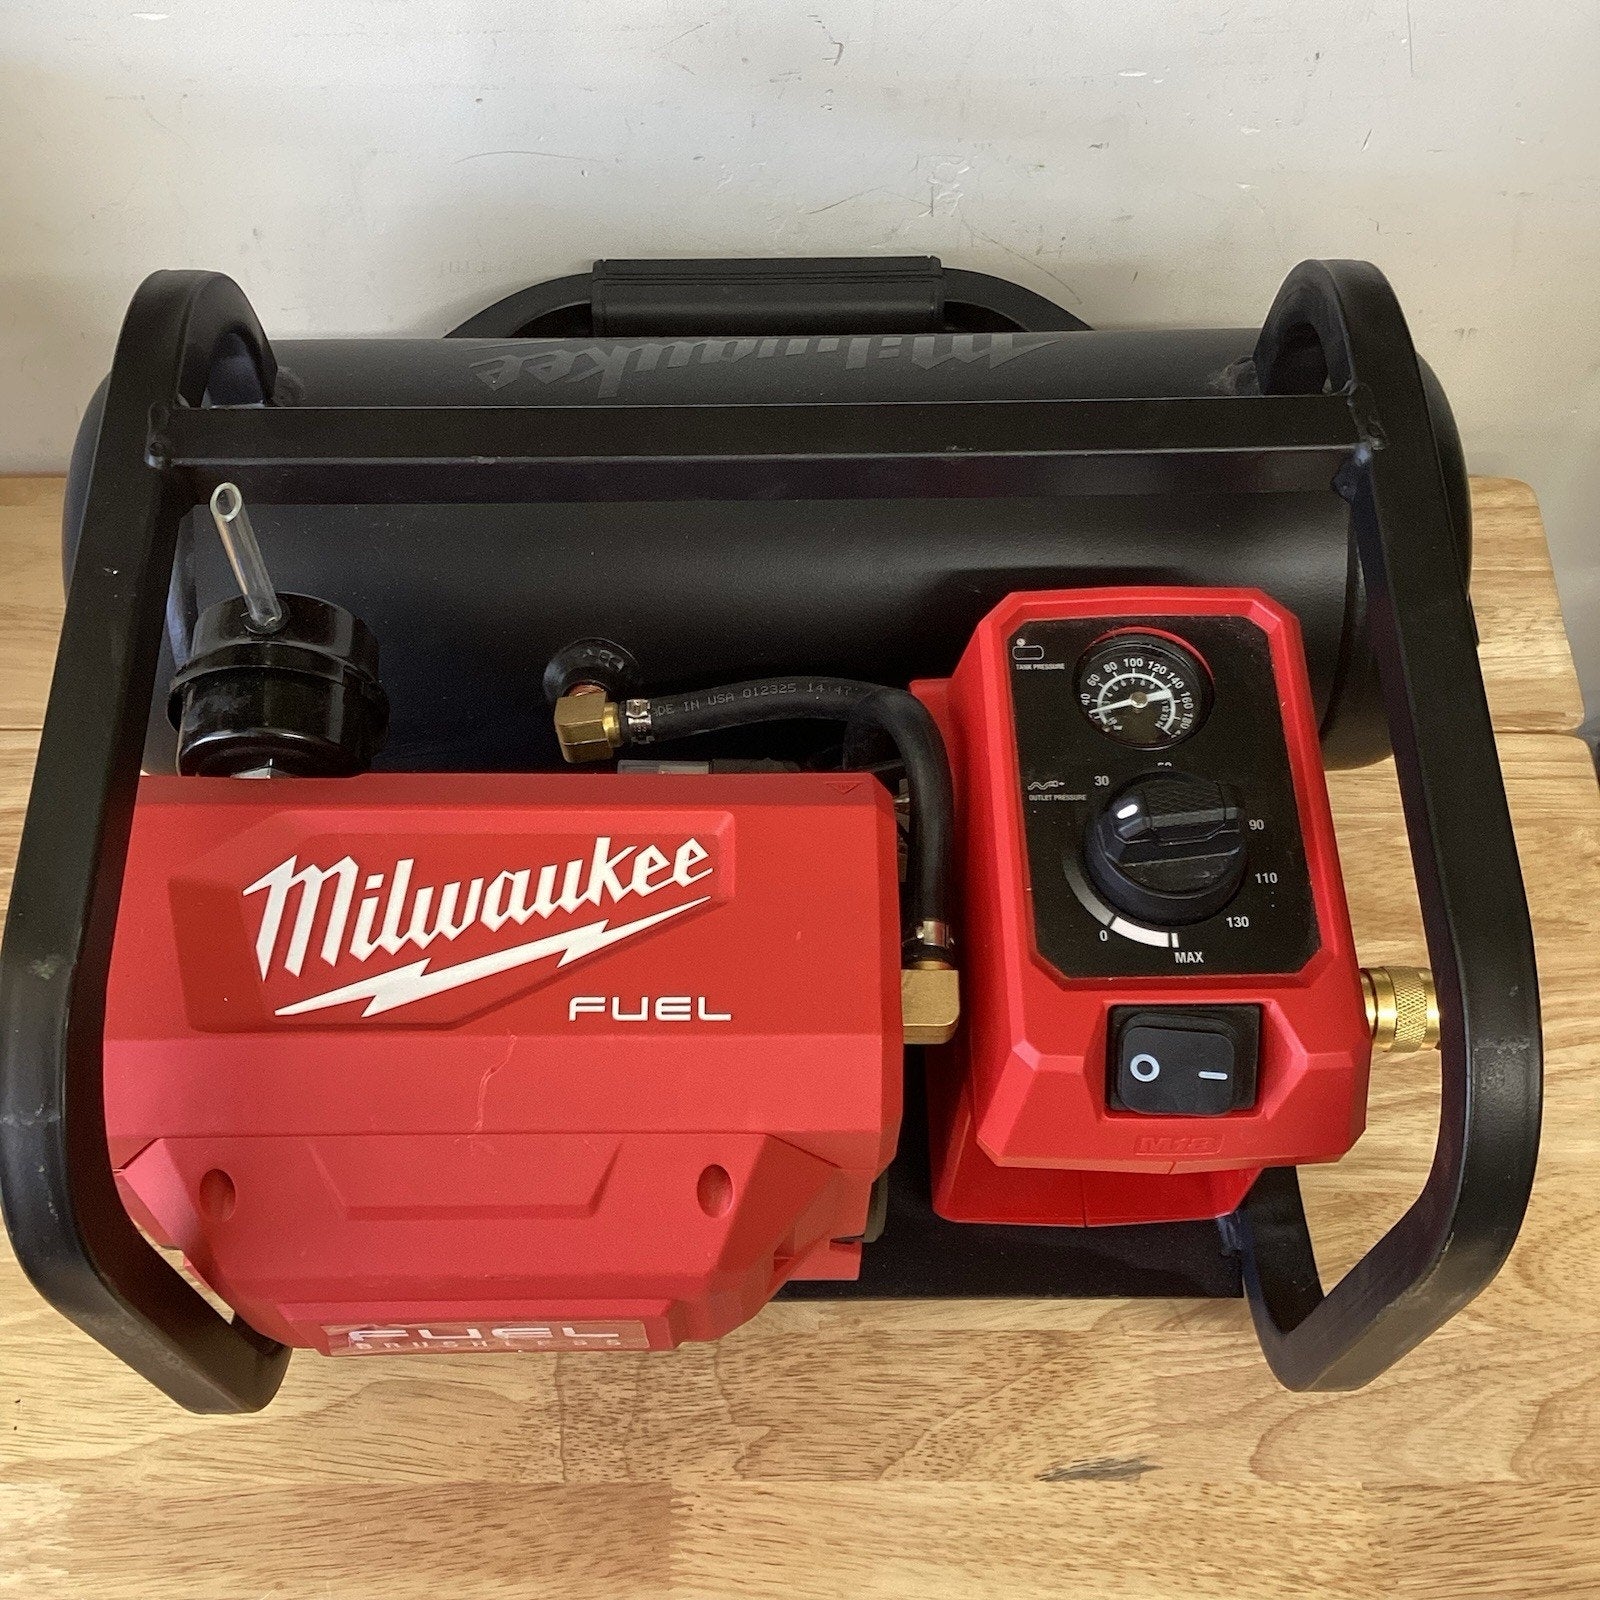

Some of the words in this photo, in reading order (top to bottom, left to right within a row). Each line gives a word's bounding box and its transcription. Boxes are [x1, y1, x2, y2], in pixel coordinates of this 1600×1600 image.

[1103, 661, 1118, 674] 80
[1123, 657, 1144, 668] 100
[1147, 660, 1168, 676] 120
[1086, 673, 1101, 687] 60
[1167, 672, 1185, 690] 140
[651, 704, 675, 718] DE
[683, 700, 700, 713] IN
[707, 691, 735, 707] USA
[741, 682, 797, 699] 012325
[1080, 693, 1091, 706] 40
[1180, 691, 1194, 710] 160
[1094, 775, 1110, 787] 30
[1028, 793, 1052, 801] OUTLET
[1053, 793, 1087, 801] PRESSURE
[1248, 819, 1265, 831] 90
[1254, 872, 1278, 884] 110
[243, 837, 713, 982] Milwaukee
[1225, 915, 1250, 928] 130
[1099, 929, 1108, 942] 0
[1174, 951, 1205, 964] MAX
[568, 995, 732, 1022] FUEL
